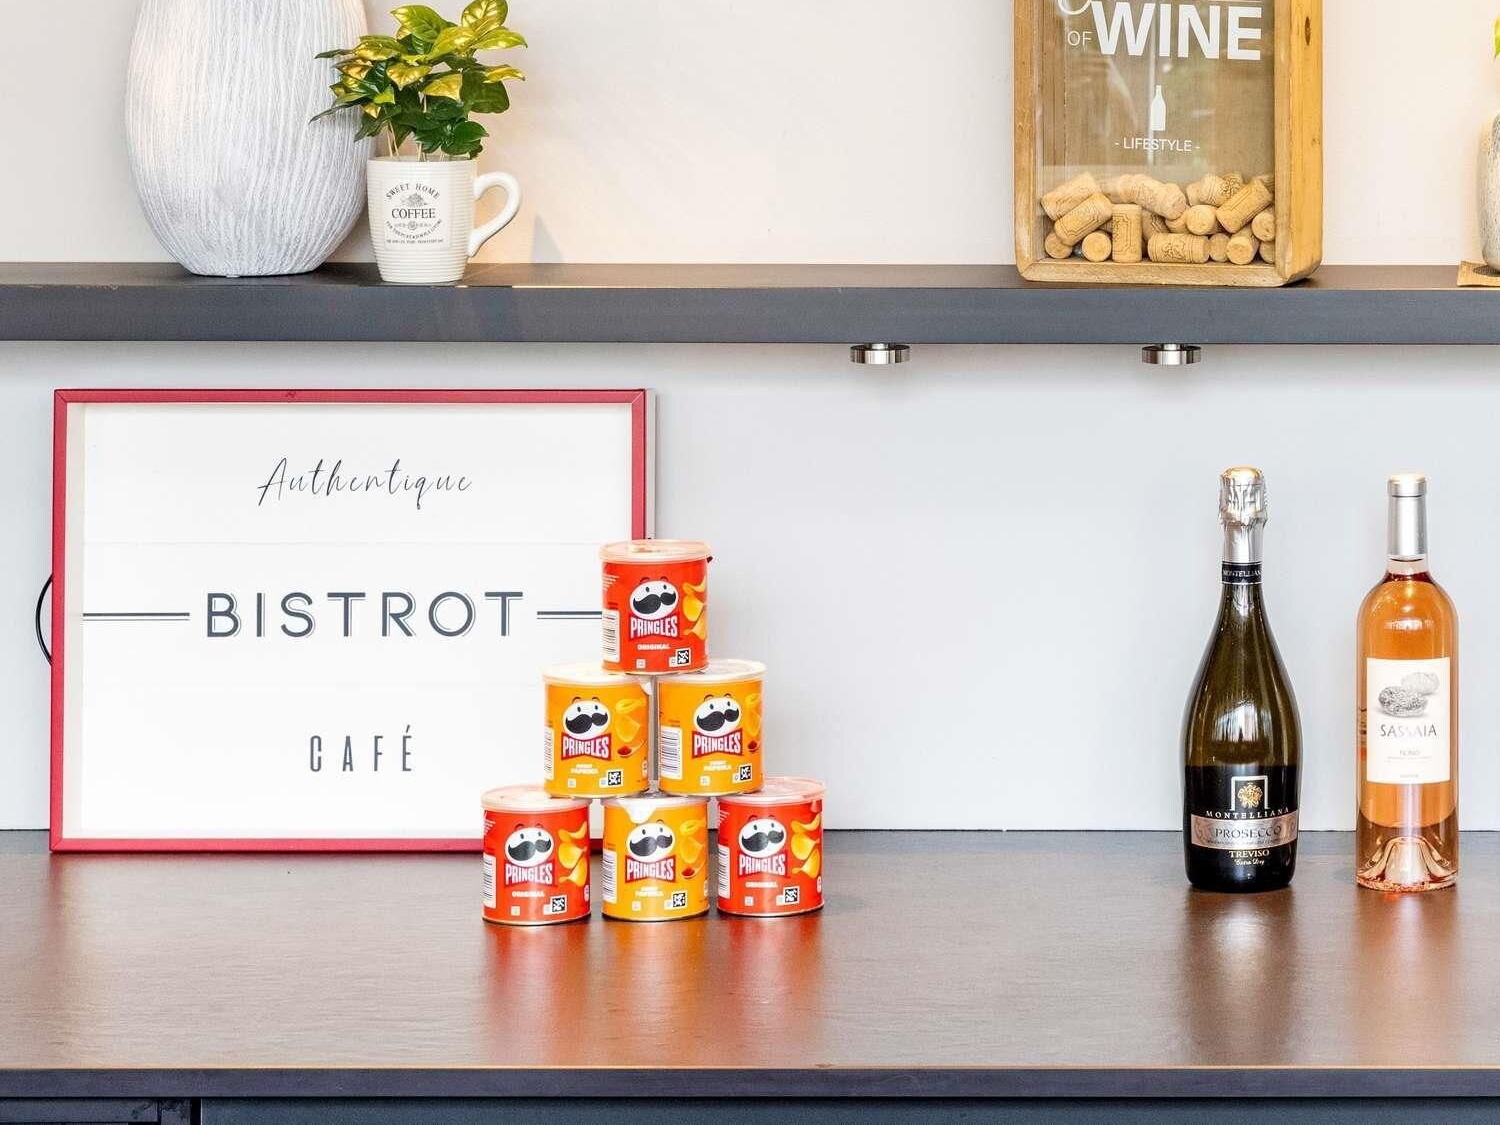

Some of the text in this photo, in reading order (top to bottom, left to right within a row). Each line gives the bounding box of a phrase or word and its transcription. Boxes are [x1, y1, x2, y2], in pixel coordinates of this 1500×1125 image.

[1067, 1, 1262, 60] OF WINE
[1123, 137, 1193, 152] LIFESTYLE
[386, 183, 440, 200] SWEET HOME
[391, 208, 436, 219] COFFEE
[257, 457, 473, 510] Authentique
[206, 591, 524, 638] BISTROT
[630, 616, 678, 639] PRINGLES
[1380, 724, 1437, 737] SASSAIA
[310, 724, 412, 772] CAFÉ
[562, 735, 609, 758] PRINGLES
[694, 731, 741, 756] PRINGLES
[1206, 807, 1289, 819] MONTELLIANA
[1215, 825, 1281, 839] PROSECCO
[739, 853, 786, 876] PRINGLES
[1229, 848, 1270, 858] TREVISO
[505, 862, 553, 885] PRINGLES
[626, 858, 674, 880] PRINGLES
